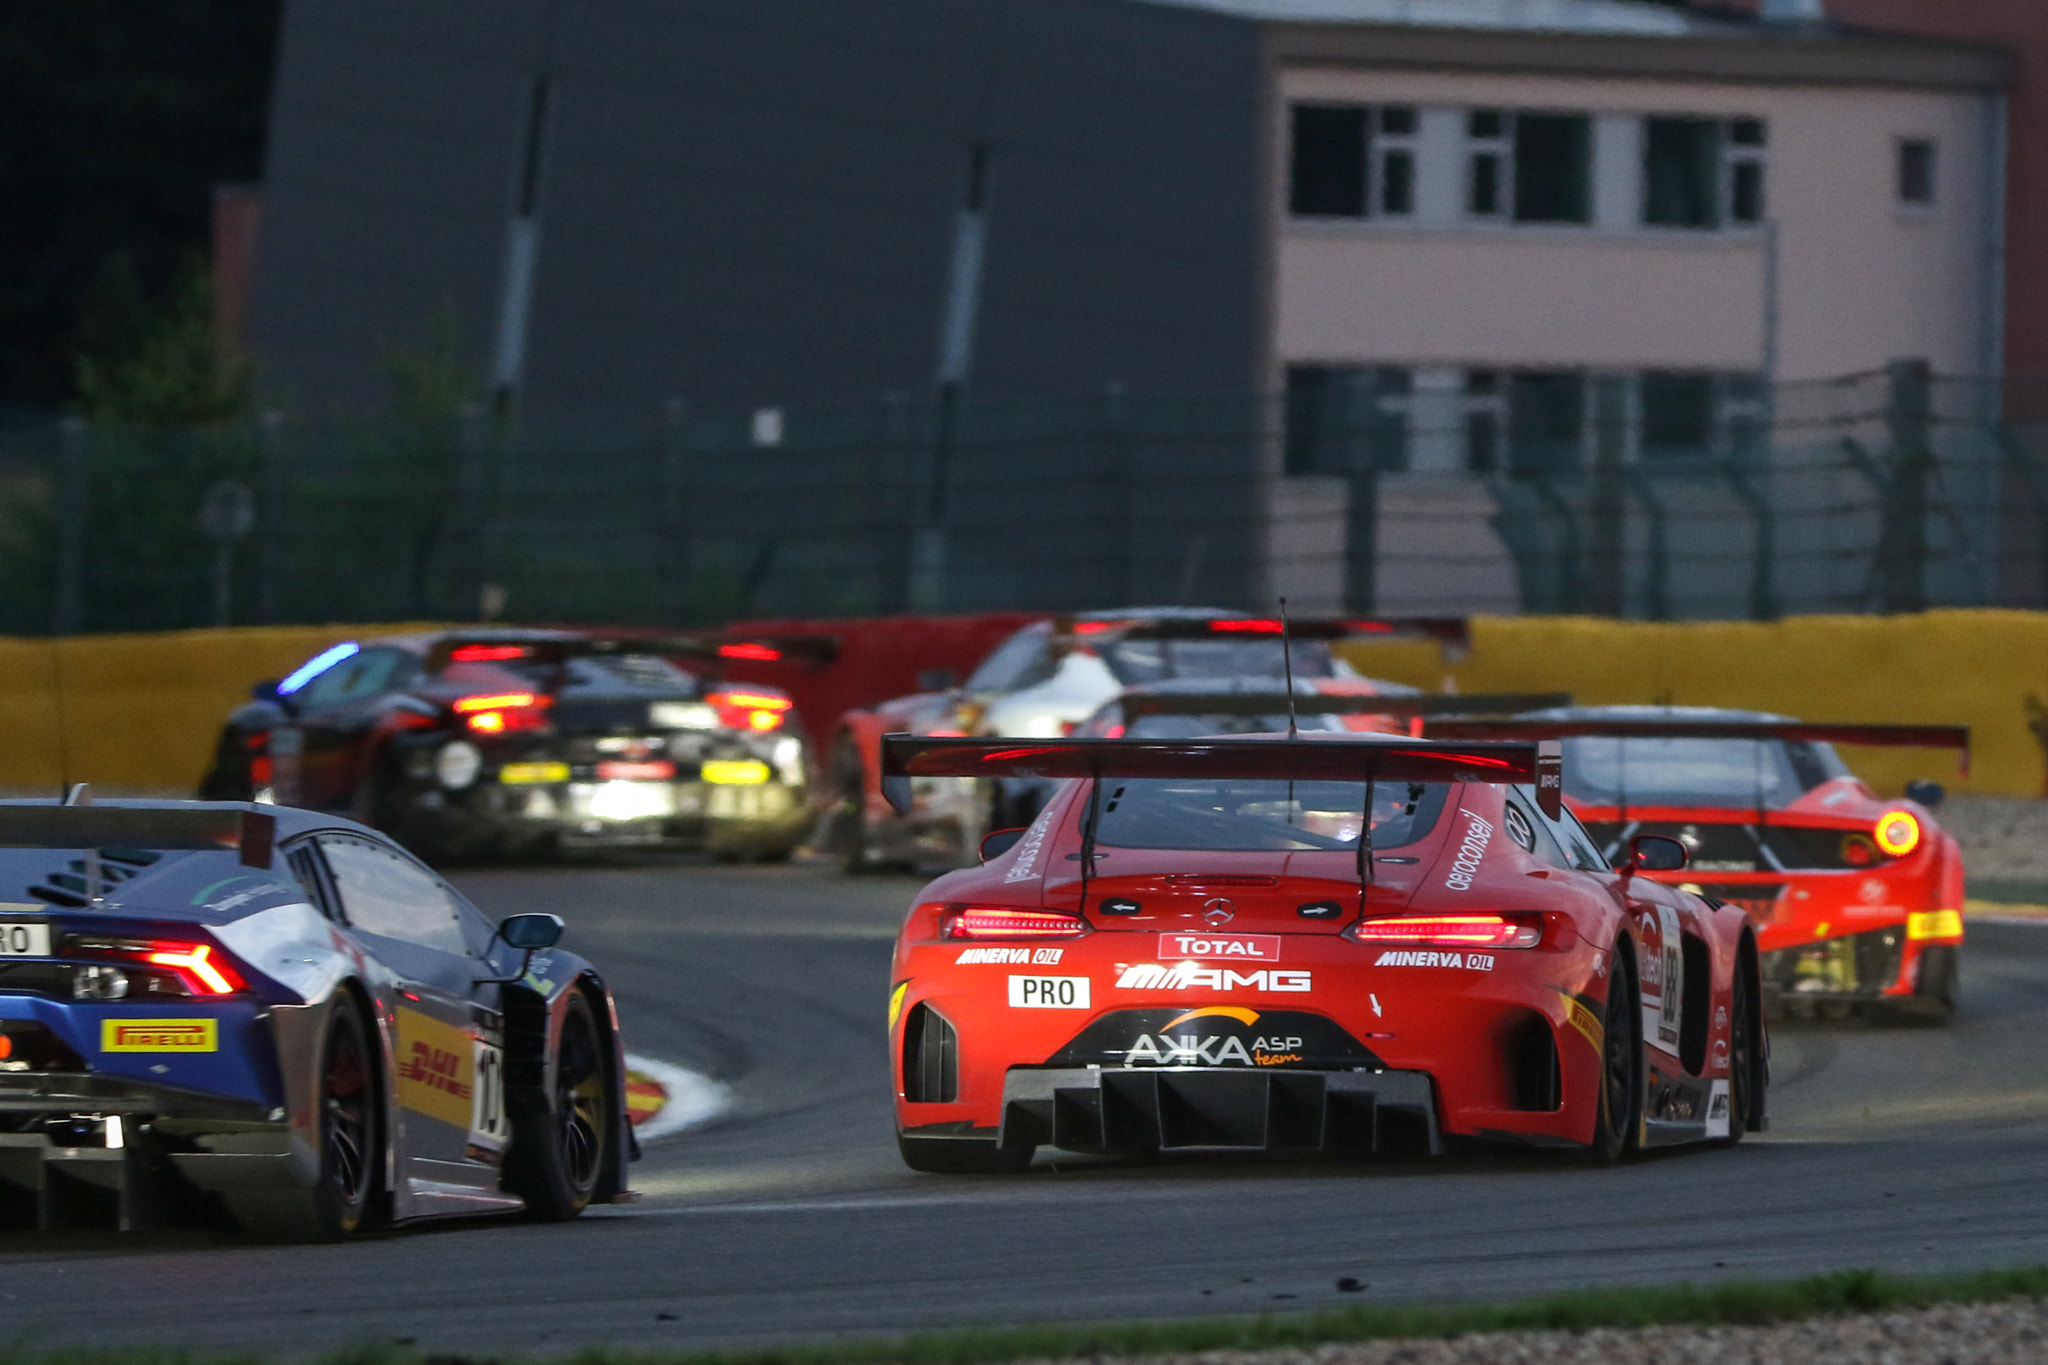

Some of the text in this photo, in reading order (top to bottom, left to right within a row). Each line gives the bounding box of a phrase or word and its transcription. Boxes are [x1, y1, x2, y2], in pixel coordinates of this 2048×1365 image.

[1445, 808, 1494, 891] aeroconseil
[0, 926, 29, 953] O
[1175, 936, 1264, 956] TOTAL
[955, 948, 1061, 964] MINERVA OIL
[1374, 951, 1494, 970] MINERVA OIL
[1170, 966, 1311, 992] AMG
[1023, 979, 1075, 1005] PRO
[117, 1026, 206, 1046] PIRELLI
[1124, 1033, 1302, 1067] AKKA ASP
[1254, 1049, 1302, 1065] team
